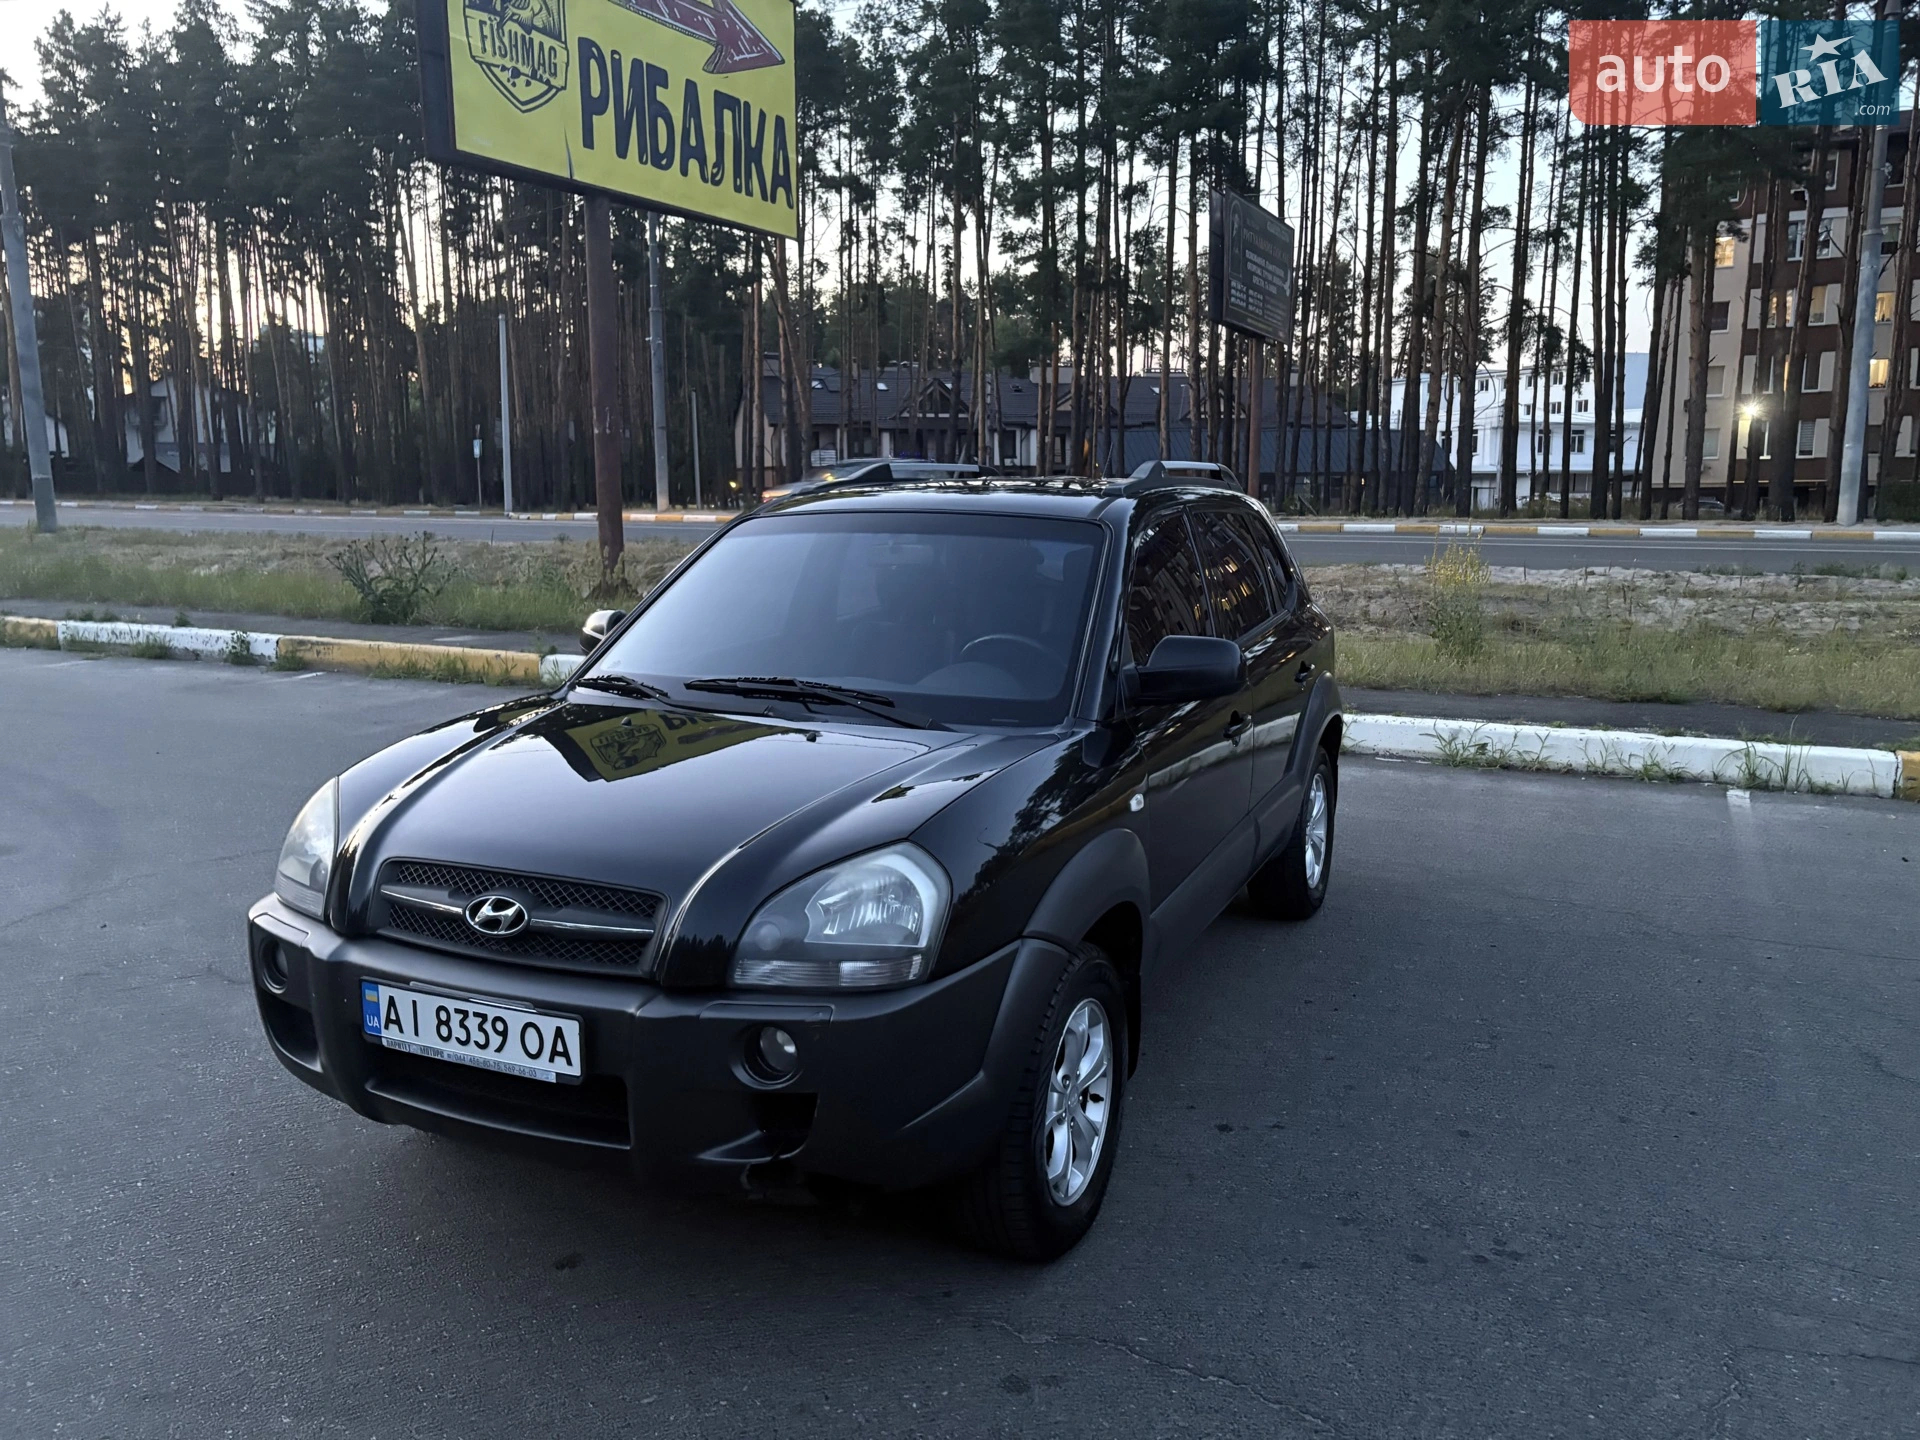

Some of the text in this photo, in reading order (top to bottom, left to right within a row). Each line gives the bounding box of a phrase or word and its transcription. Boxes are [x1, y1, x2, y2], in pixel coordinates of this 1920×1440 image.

[577, 36, 795, 210] РИБАЛКА
[367, 1015, 380, 1029] UA
[384, 995, 573, 1067] AI 8339 OA
